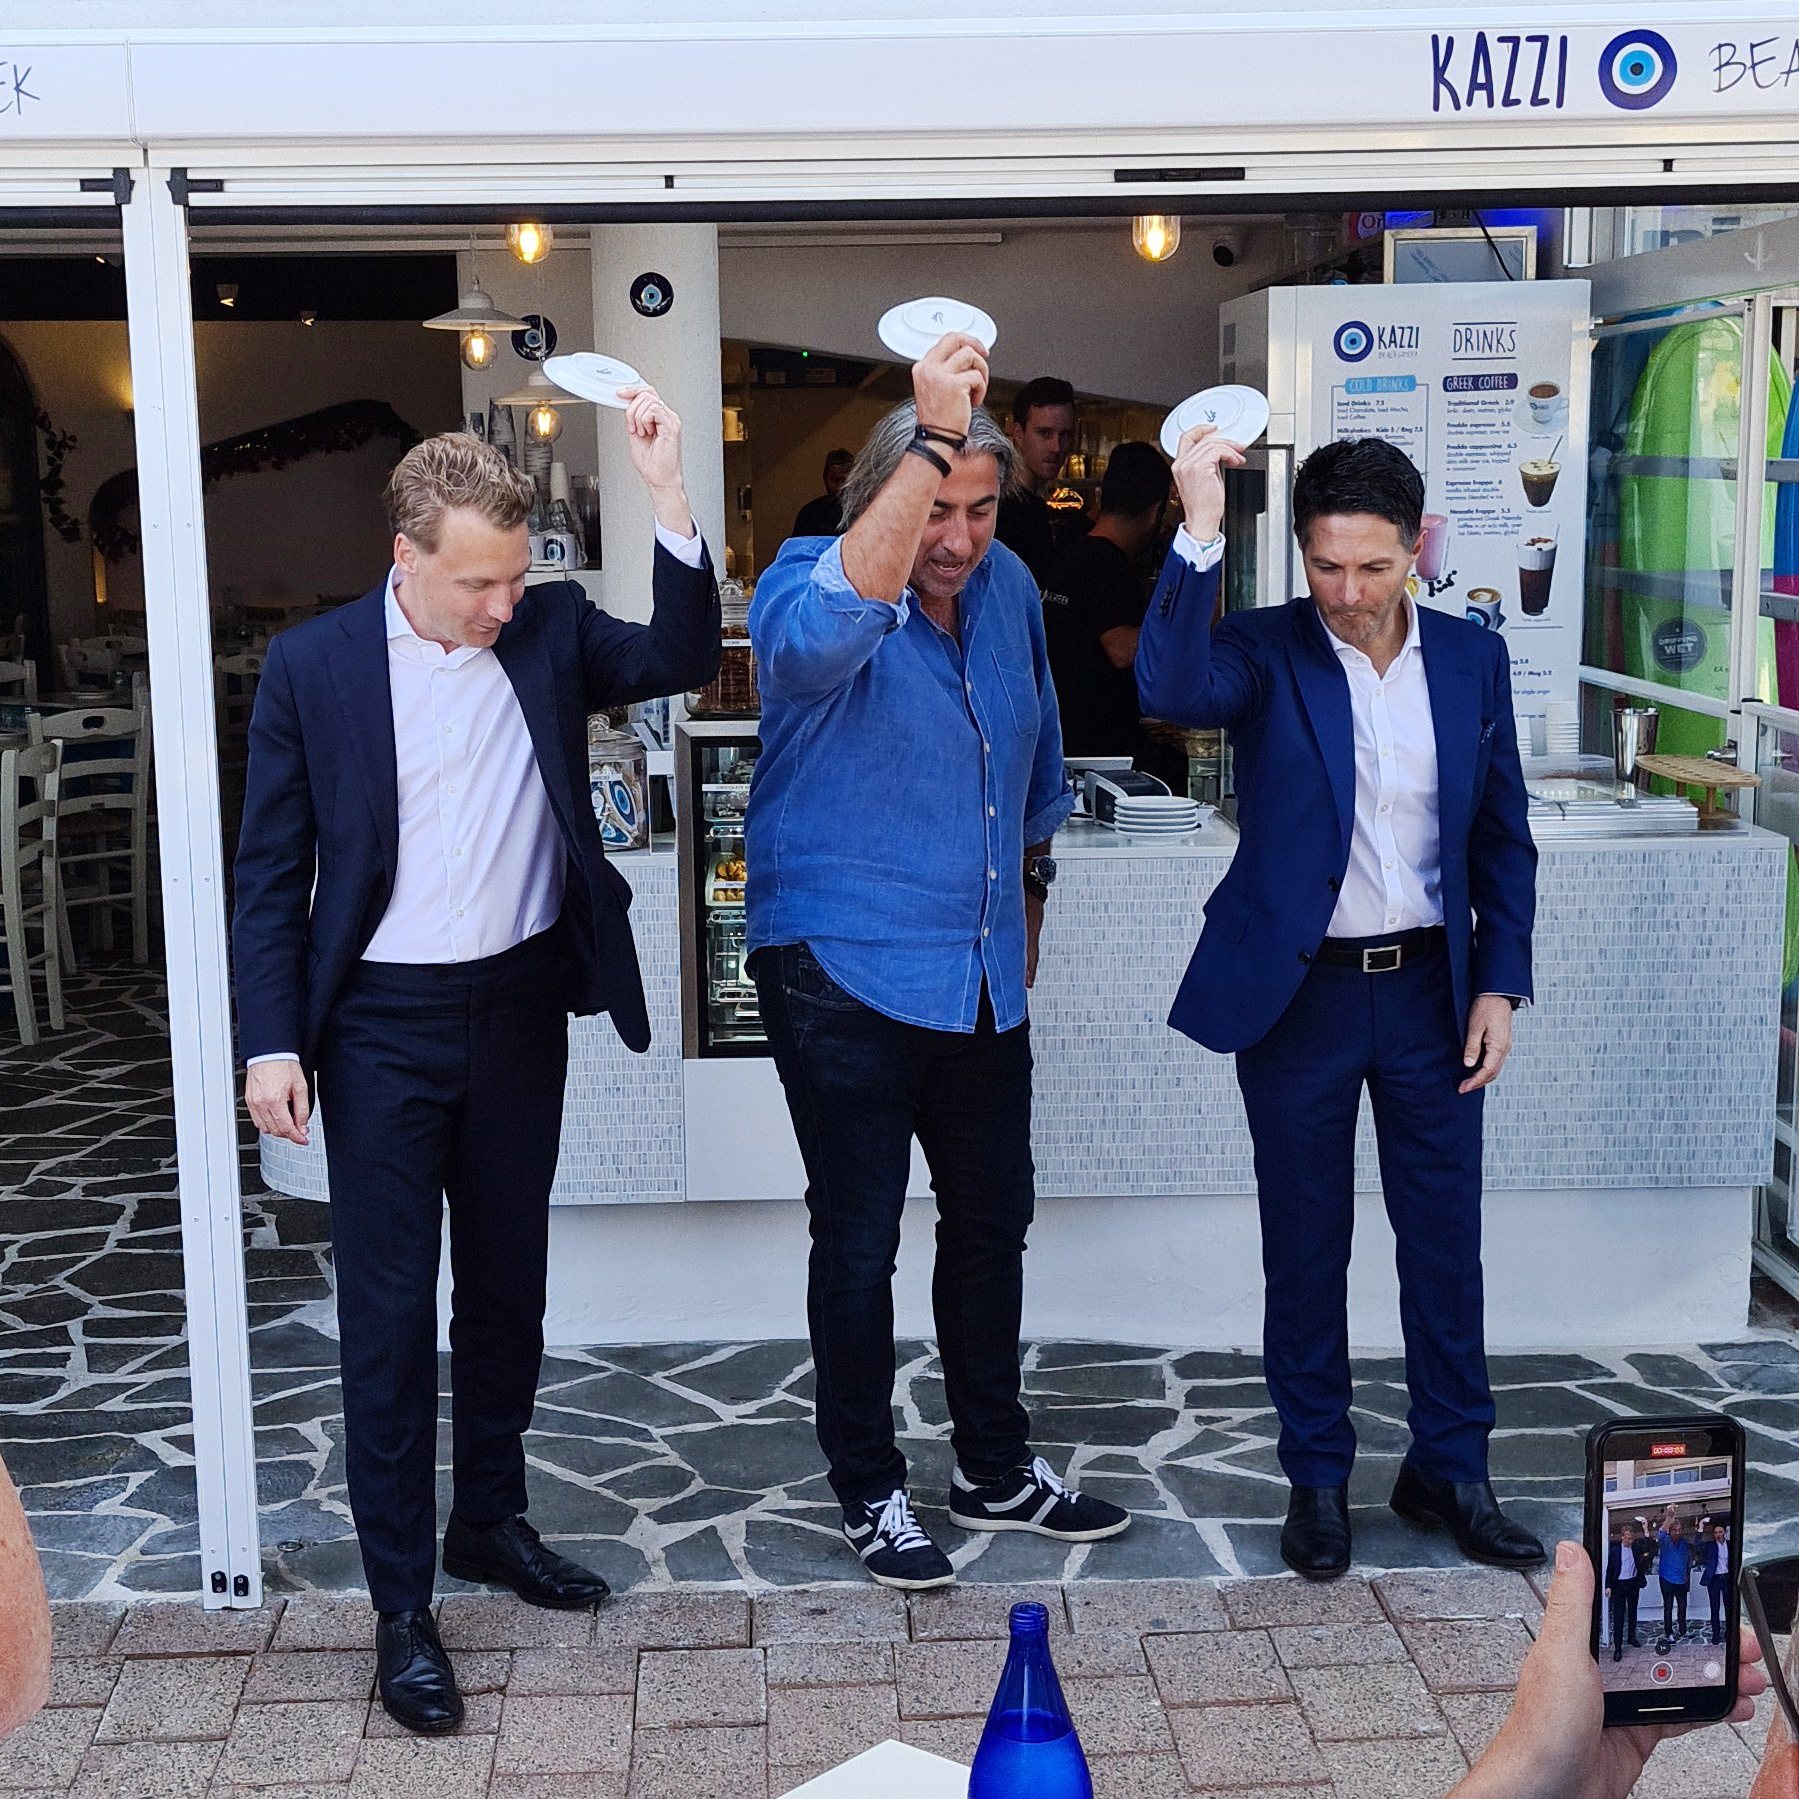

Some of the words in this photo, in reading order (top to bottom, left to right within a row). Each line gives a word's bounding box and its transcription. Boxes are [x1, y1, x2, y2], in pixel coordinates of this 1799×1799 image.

[1431, 31, 1568, 112] KAZZI
[1377, 325, 1420, 350] KAZZI
[1453, 327, 1516, 353] DRINKS
[1349, 379, 1372, 392] COLD
[1376, 378, 1409, 391] DRINKS
[1446, 377, 1474, 390] GREEK
[1478, 376, 1508, 389] COFFEE
[1664, 643, 1694, 655] WET
